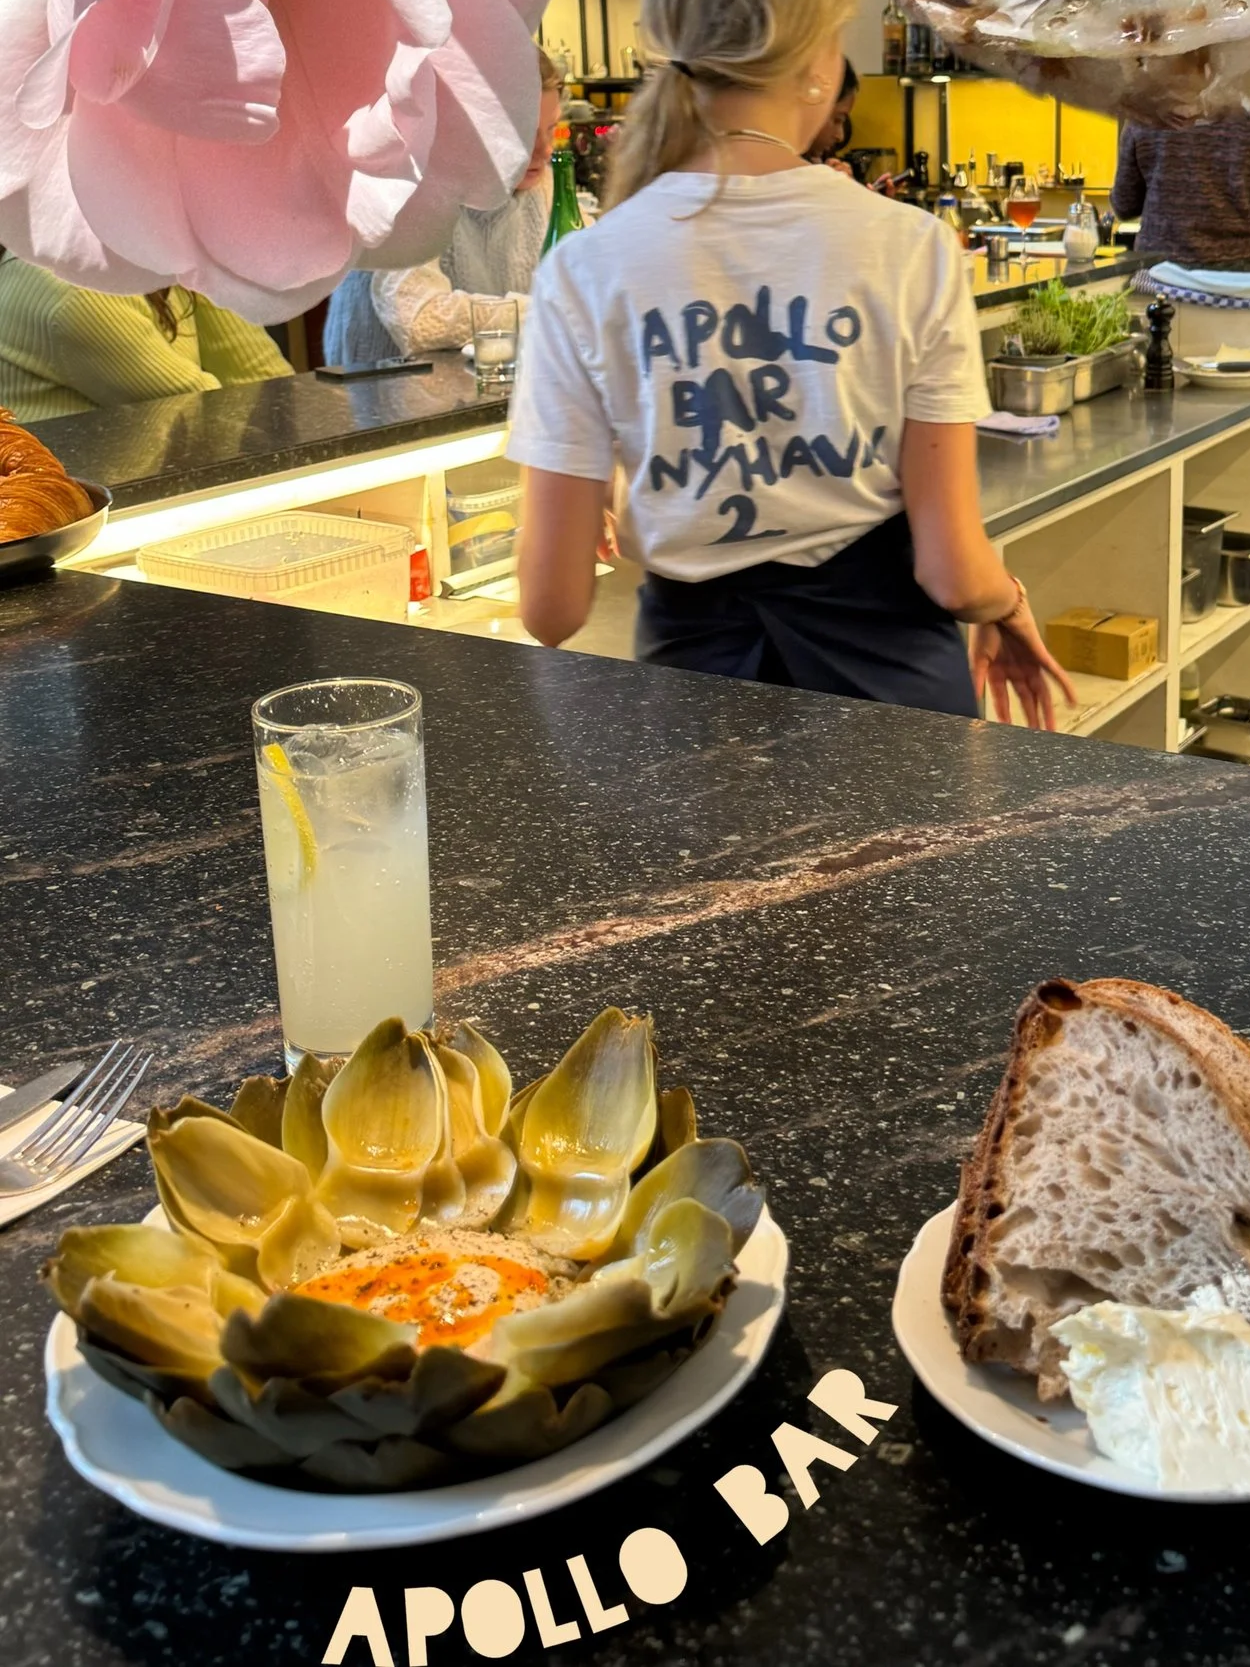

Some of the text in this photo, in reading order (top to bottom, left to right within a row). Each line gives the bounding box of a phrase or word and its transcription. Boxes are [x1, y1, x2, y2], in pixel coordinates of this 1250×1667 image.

[642, 285, 862, 378] APOLLO
[672, 364, 796, 454] BAR
[705, 494, 788, 546] 2
